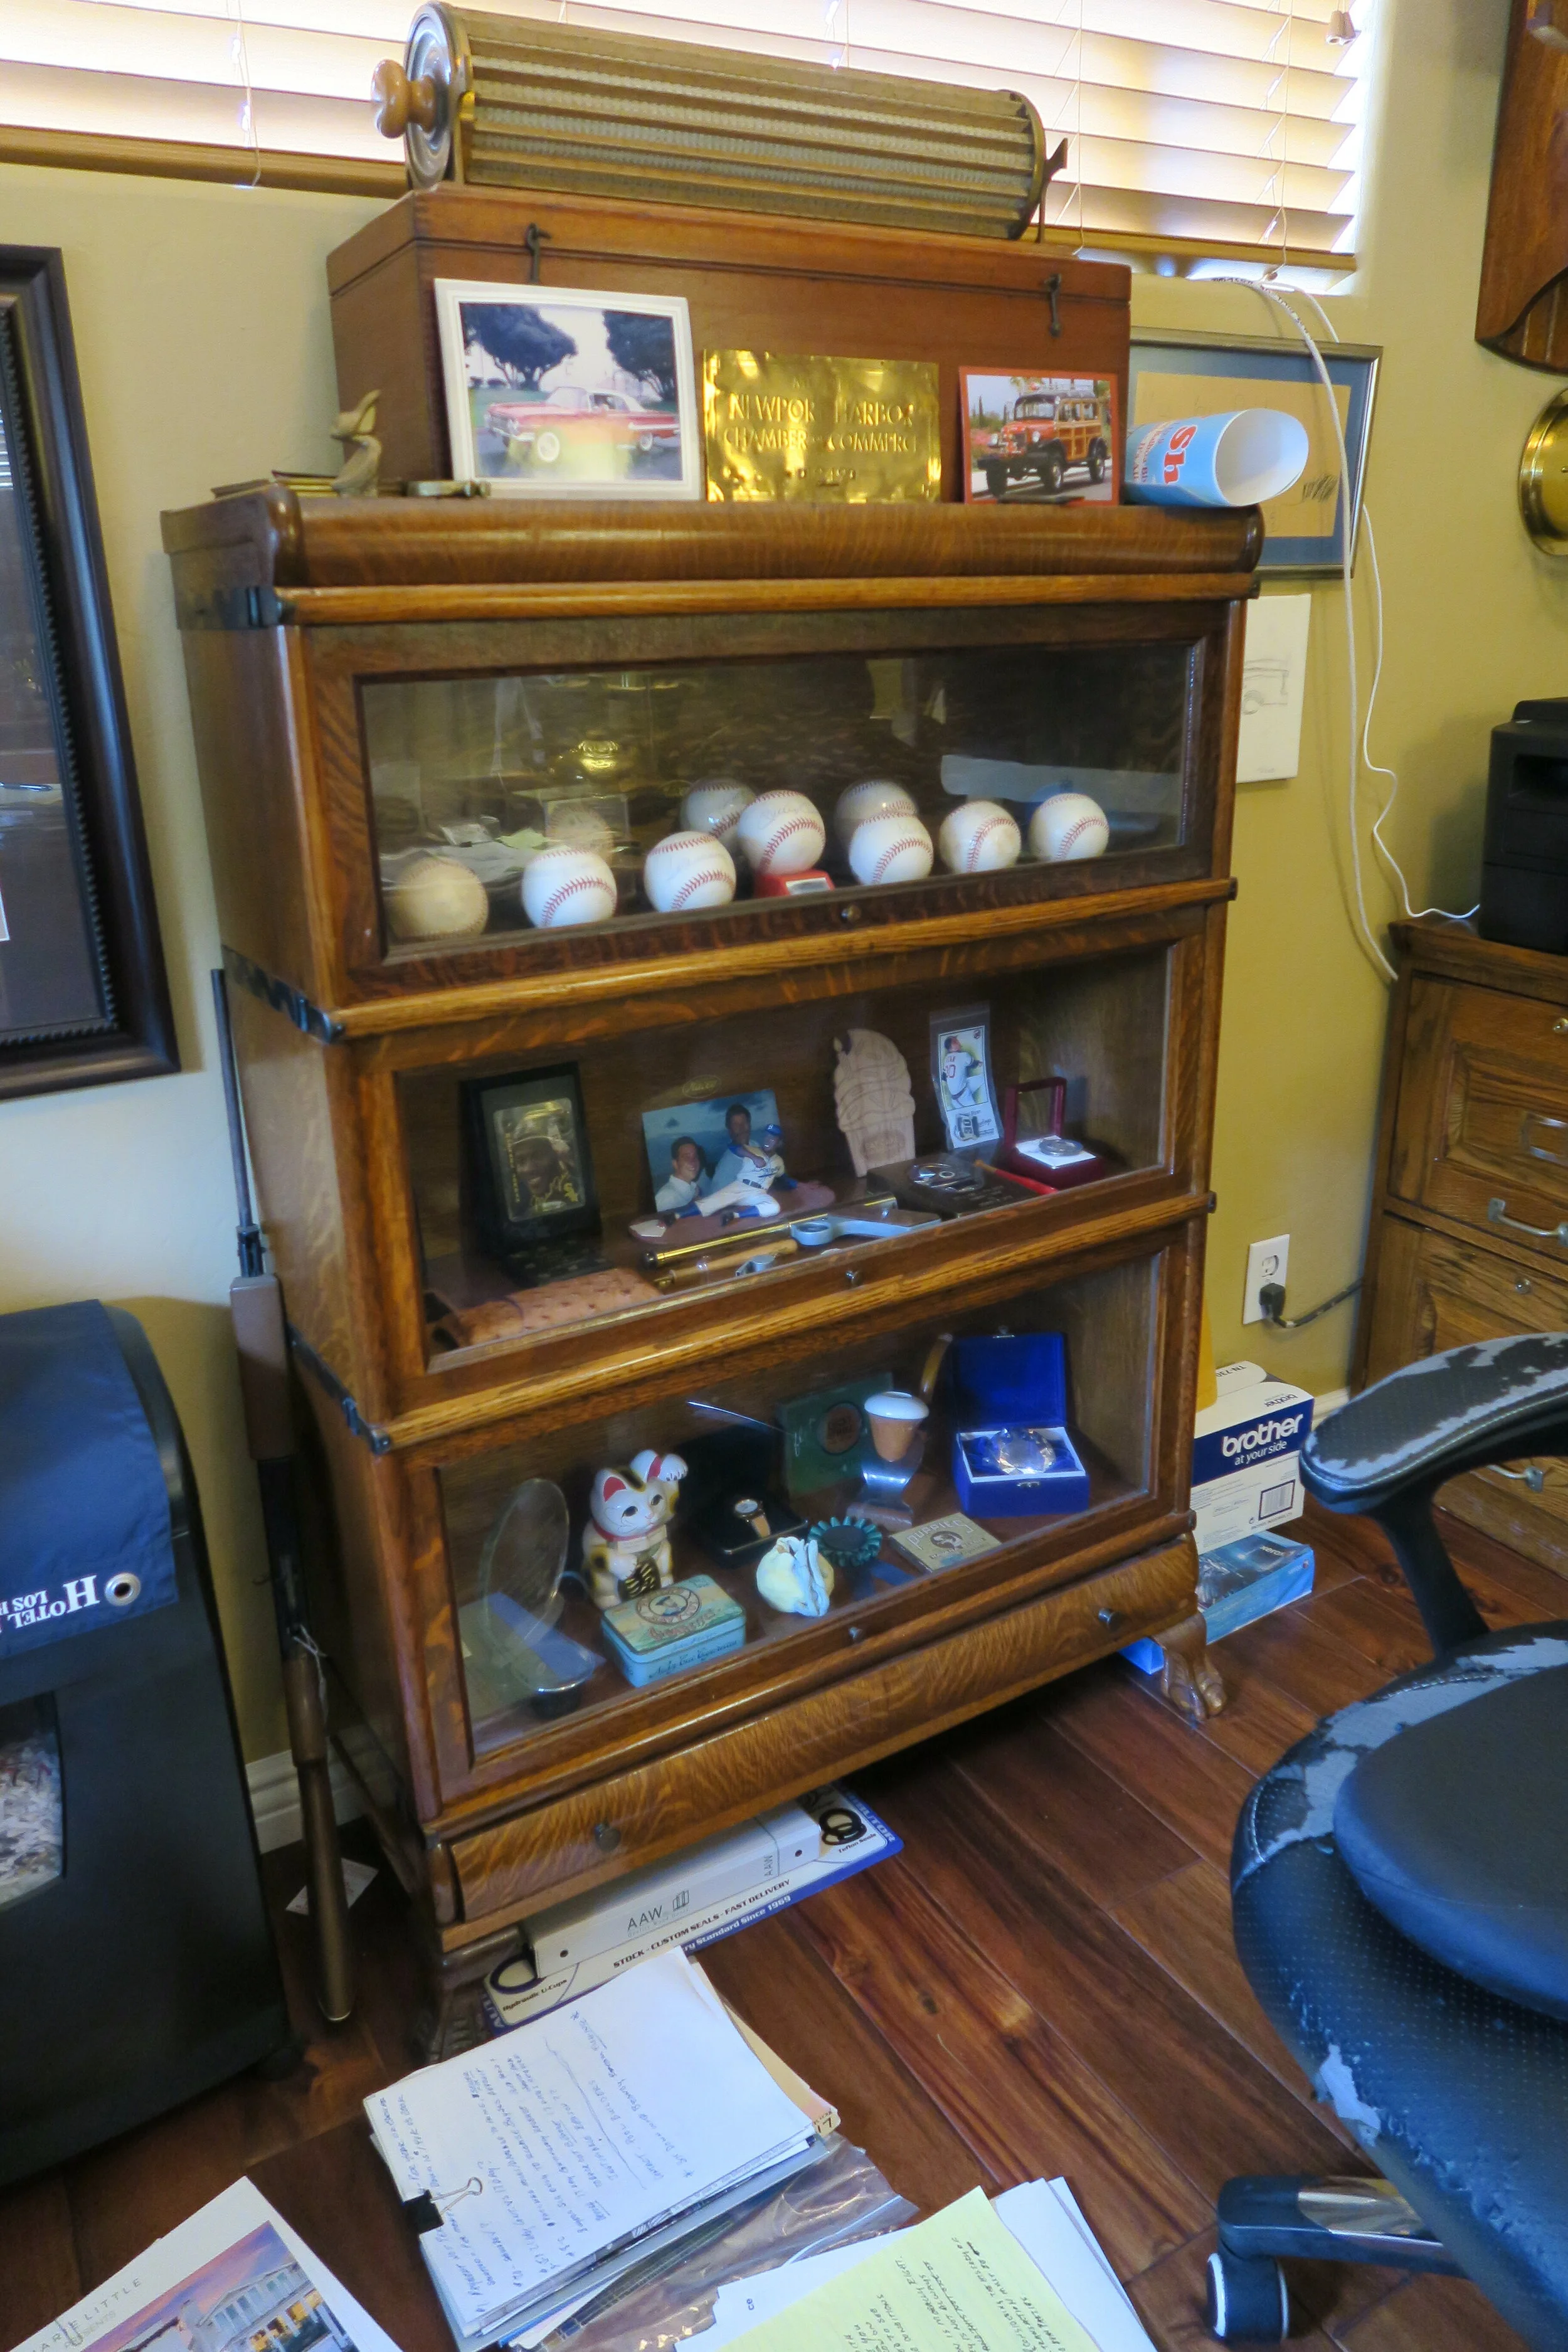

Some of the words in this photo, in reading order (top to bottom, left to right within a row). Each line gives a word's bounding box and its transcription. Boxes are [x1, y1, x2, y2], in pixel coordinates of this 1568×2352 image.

[728, 394, 822, 424] NEWPOR
[724, 426, 808, 452] CHAMBER
[1264, 1394, 1298, 1407] brother
[1222, 1414, 1304, 1457] brother
[1234, 1455, 1245, 1466] at
[1246, 1448, 1268, 1465] your
[1268, 1440, 1288, 1454] side
[12, 1590, 48, 1611] LOS
[859, 1833, 877, 1843] Seals
[765, 1855, 773, 1877] AAW
[613, 1949, 645, 1968] STOCK
[651, 1928, 689, 1951] CUSTOM
[691, 1913, 719, 1932] SEALS
[725, 1900, 748, 1915] FAST
[748, 1879, 790, 1904] DELIVERY
[627, 1905, 663, 1931] AAW
[697, 1920, 740, 1945] Standard
[740, 1909, 766, 1925] Since
[768, 1895, 792, 1912] 1969
[502, 1991, 540, 2011] Hydraulic
